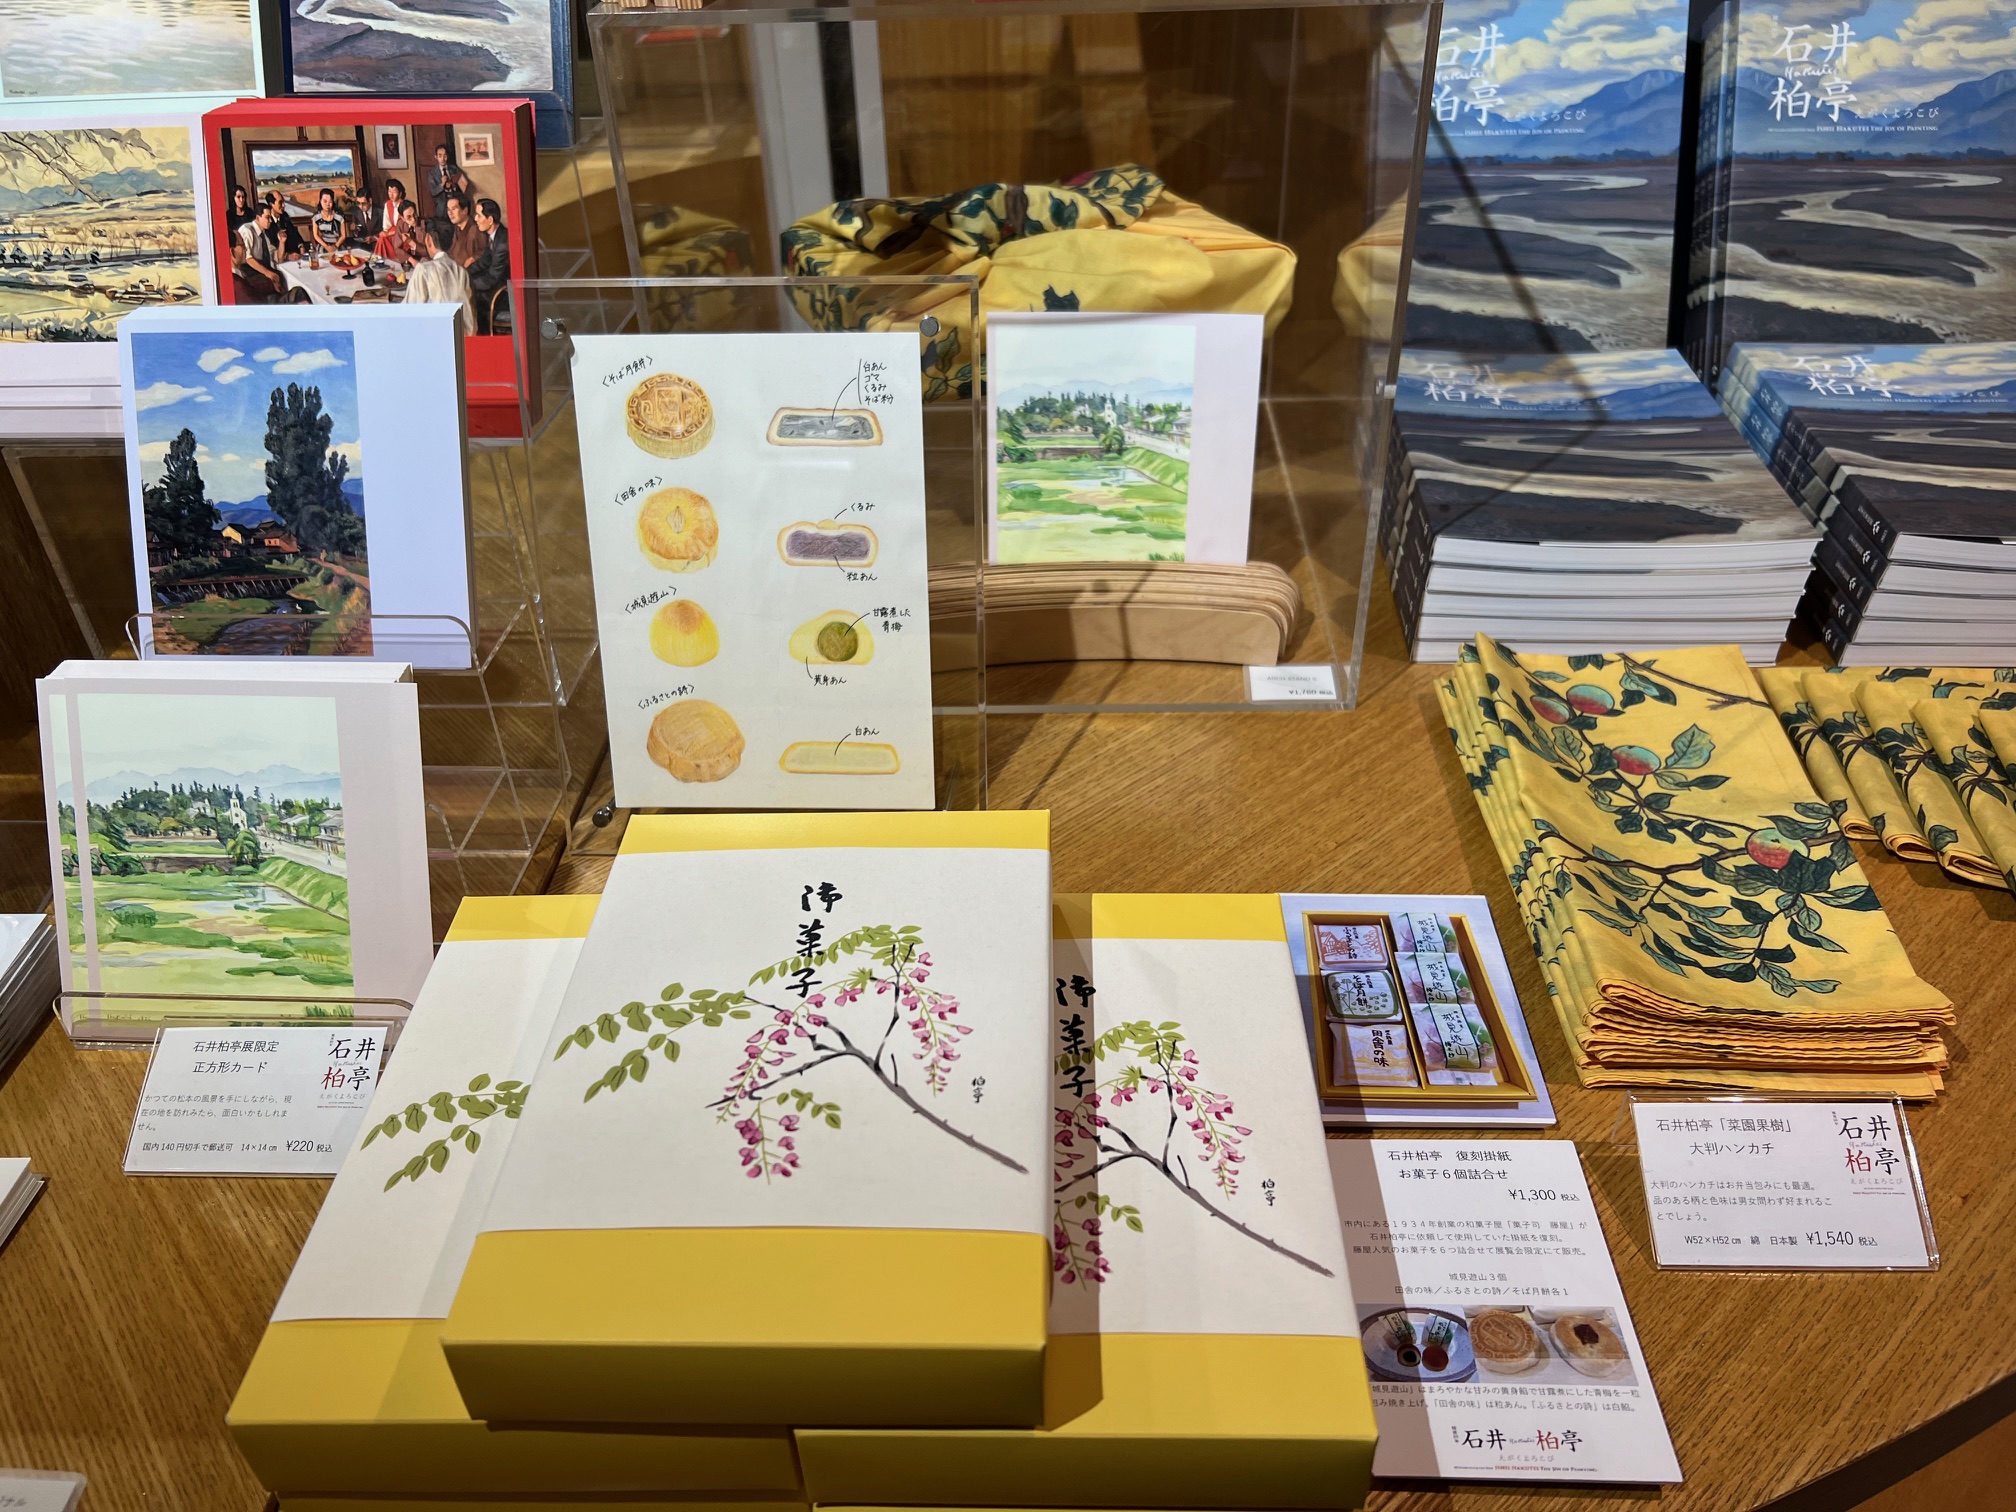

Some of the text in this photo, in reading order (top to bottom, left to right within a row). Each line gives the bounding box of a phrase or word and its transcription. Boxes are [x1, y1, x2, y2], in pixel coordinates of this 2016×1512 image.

[1772, 21, 1858, 66] 石井
[1768, 77, 1857, 122] 柏亭
[863, 361, 887, 372] 白あん
[864, 373, 880, 383] ゴマ
[864, 383, 887, 393] くるみ
[864, 394, 894, 406] そば粉
[851, 502, 875, 512] くるみ
[847, 572, 878, 582] 粒あん
[873, 607, 911, 618] 甘露煮した
[882, 620, 903, 633] 青梅
[814, 674, 847, 686] 黄身あん
[855, 726, 880, 736] 白あん
[785, 882, 843, 998] 御菓子
[1352, 974, 1368, 1008] そば月餅
[1056, 975, 1096, 1097] 御菓子
[192, 1041, 280, 1053] 石井柏亭展限定
[328, 1037, 376, 1060] 石井
[1371, 1029, 1389, 1067] 田舎の味
[192, 1061, 268, 1074] 正方形カード
[321, 1066, 370, 1091] 柏亭
[144, 1095, 292, 1104] かつての松本の風景を手にしながら、現
[138, 1123, 157, 1131] せん。
[1656, 1118, 1792, 1133] 石井柏亭「菜園果樹」
[1838, 1114, 1891, 1141] 石井
[286, 1140, 314, 1151] ¥220
[316, 1144, 333, 1153] 税込
[1690, 1142, 1774, 1155] 大判ハンカチ
[1387, 1150, 1513, 1162] 石井柏亭 復刻掛紙
[1845, 1147, 1900, 1175] 柏亭
[1399, 1169, 1508, 1180] お菓子6個詰合せ
[1650, 1180, 1815, 1191] 大判のハンカチはお弁当包みにも最適。
[1508, 1188, 1580, 1202] ¥1,300 税込
[1653, 1196, 1833, 1206] 品のある柄と色味は男女問わず好まれるこ
[1656, 1212, 1708, 1222] とでしょう。
[1770, 1236, 1798, 1246] 日本製
[1806, 1231, 1854, 1247] ¥1,540
[1858, 1236, 1878, 1246] 税込
[1462, 1428, 1507, 1450] 石井
[1536, 1429, 1583, 1452] 柏亭
